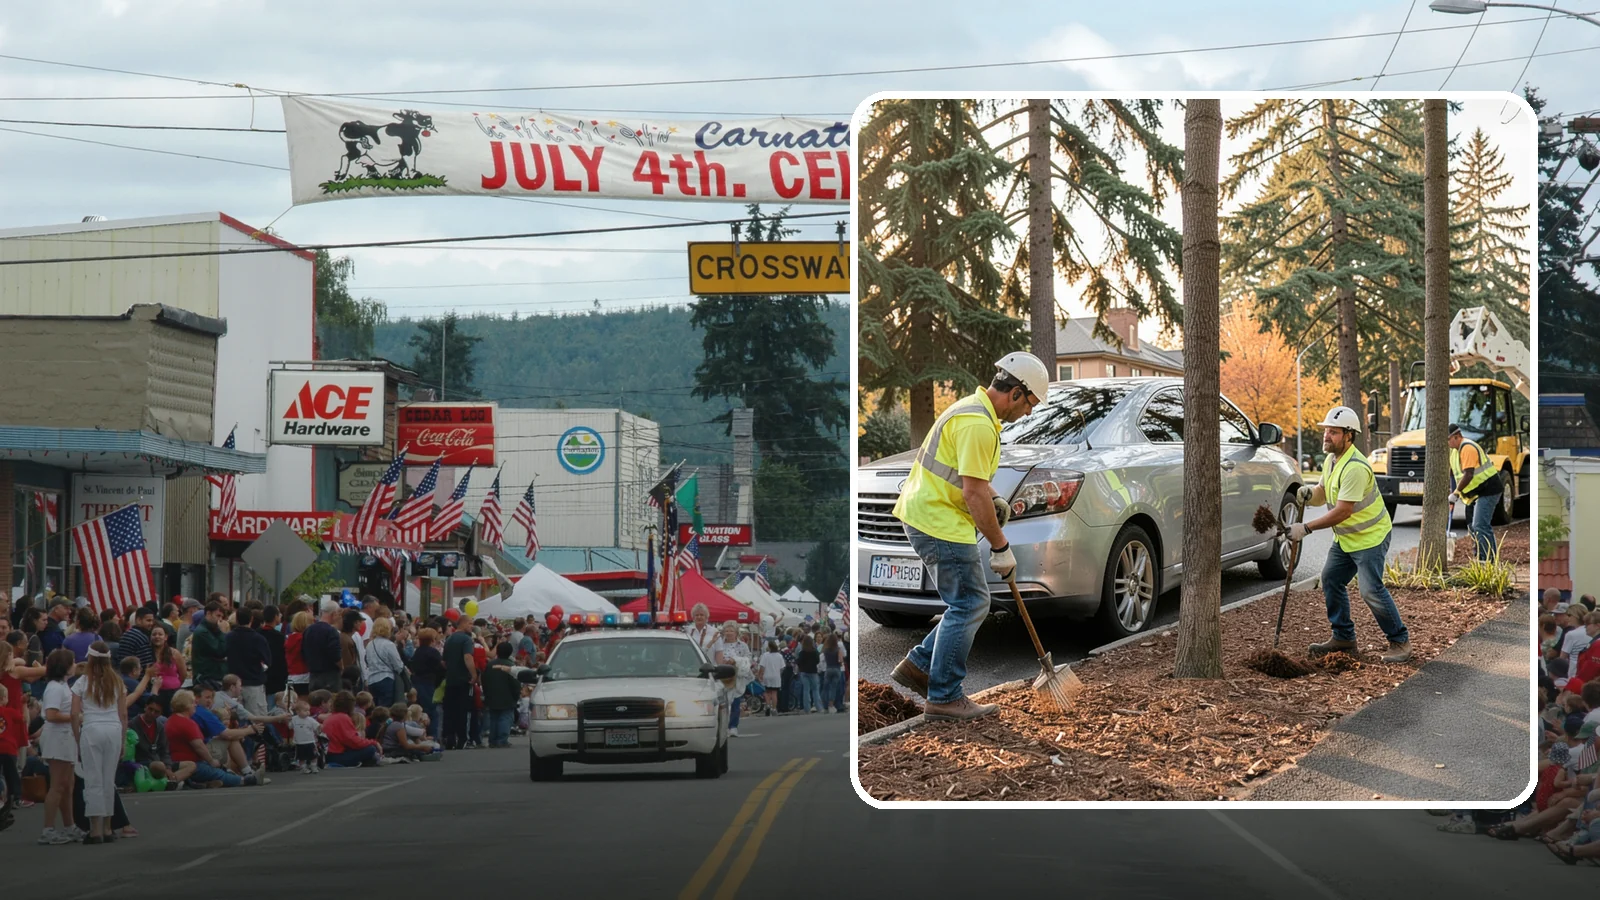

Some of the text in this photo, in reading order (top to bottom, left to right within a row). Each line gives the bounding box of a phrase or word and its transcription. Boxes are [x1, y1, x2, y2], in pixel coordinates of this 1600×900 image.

[481, 141, 605, 192] JULY
[632, 150, 746, 198] 4th.
[697, 254, 850, 280] CROSSWA
[282, 380, 373, 420] ACE
[406, 409, 453, 422] CEDAR
[283, 421, 371, 436] Hardware
[416, 428, 476, 447] Coca-Cola
[353, 467, 387, 481] Simpl
[83, 485, 155, 495] St. Vincent de Paul
[80, 503, 154, 522] THT
[688, 526, 741, 535] CRNATION
[699, 535, 730, 543] GLASS
